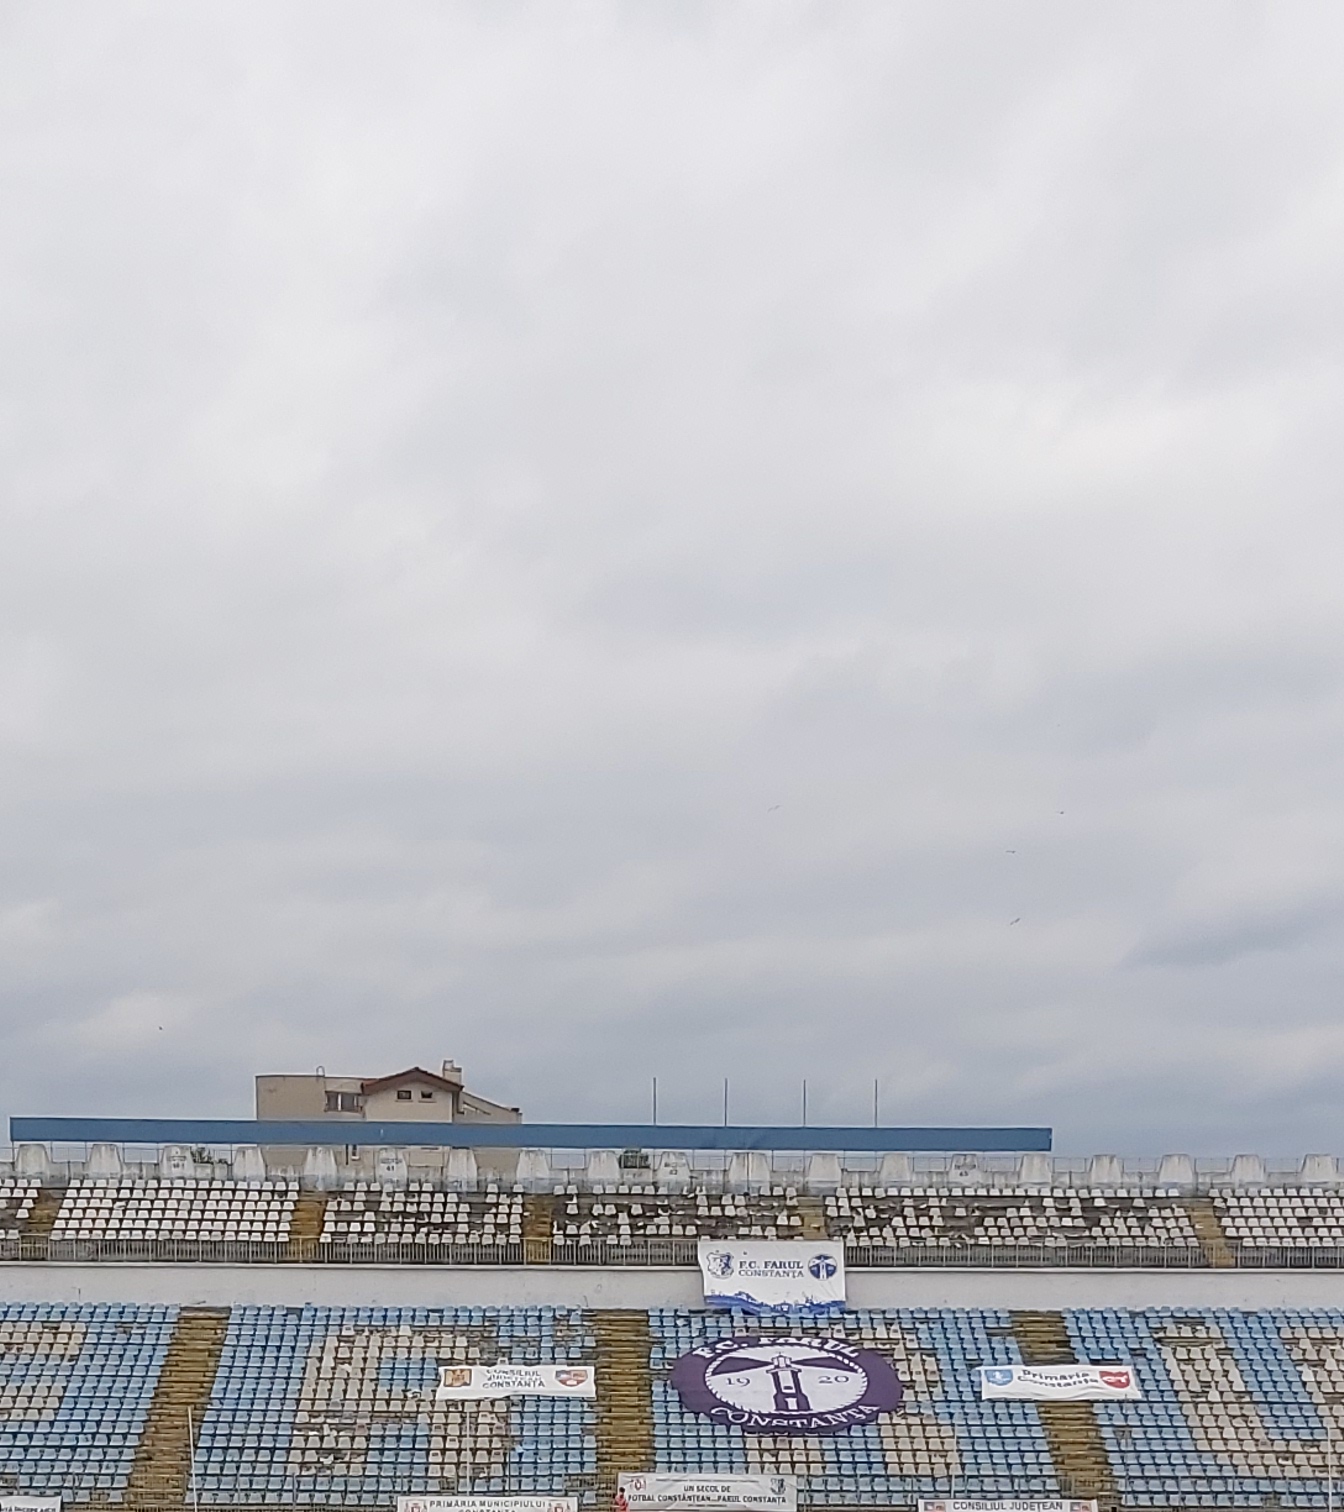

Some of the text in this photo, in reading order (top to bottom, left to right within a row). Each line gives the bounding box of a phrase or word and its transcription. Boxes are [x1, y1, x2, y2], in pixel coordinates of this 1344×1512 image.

[764, 1260, 804, 1269] FARUL
[726, 1375, 850, 1387] 19 20
[479, 1500, 546, 1508] MUNICIPIULUI
[952, 1501, 1006, 1511] CONSILIUL
